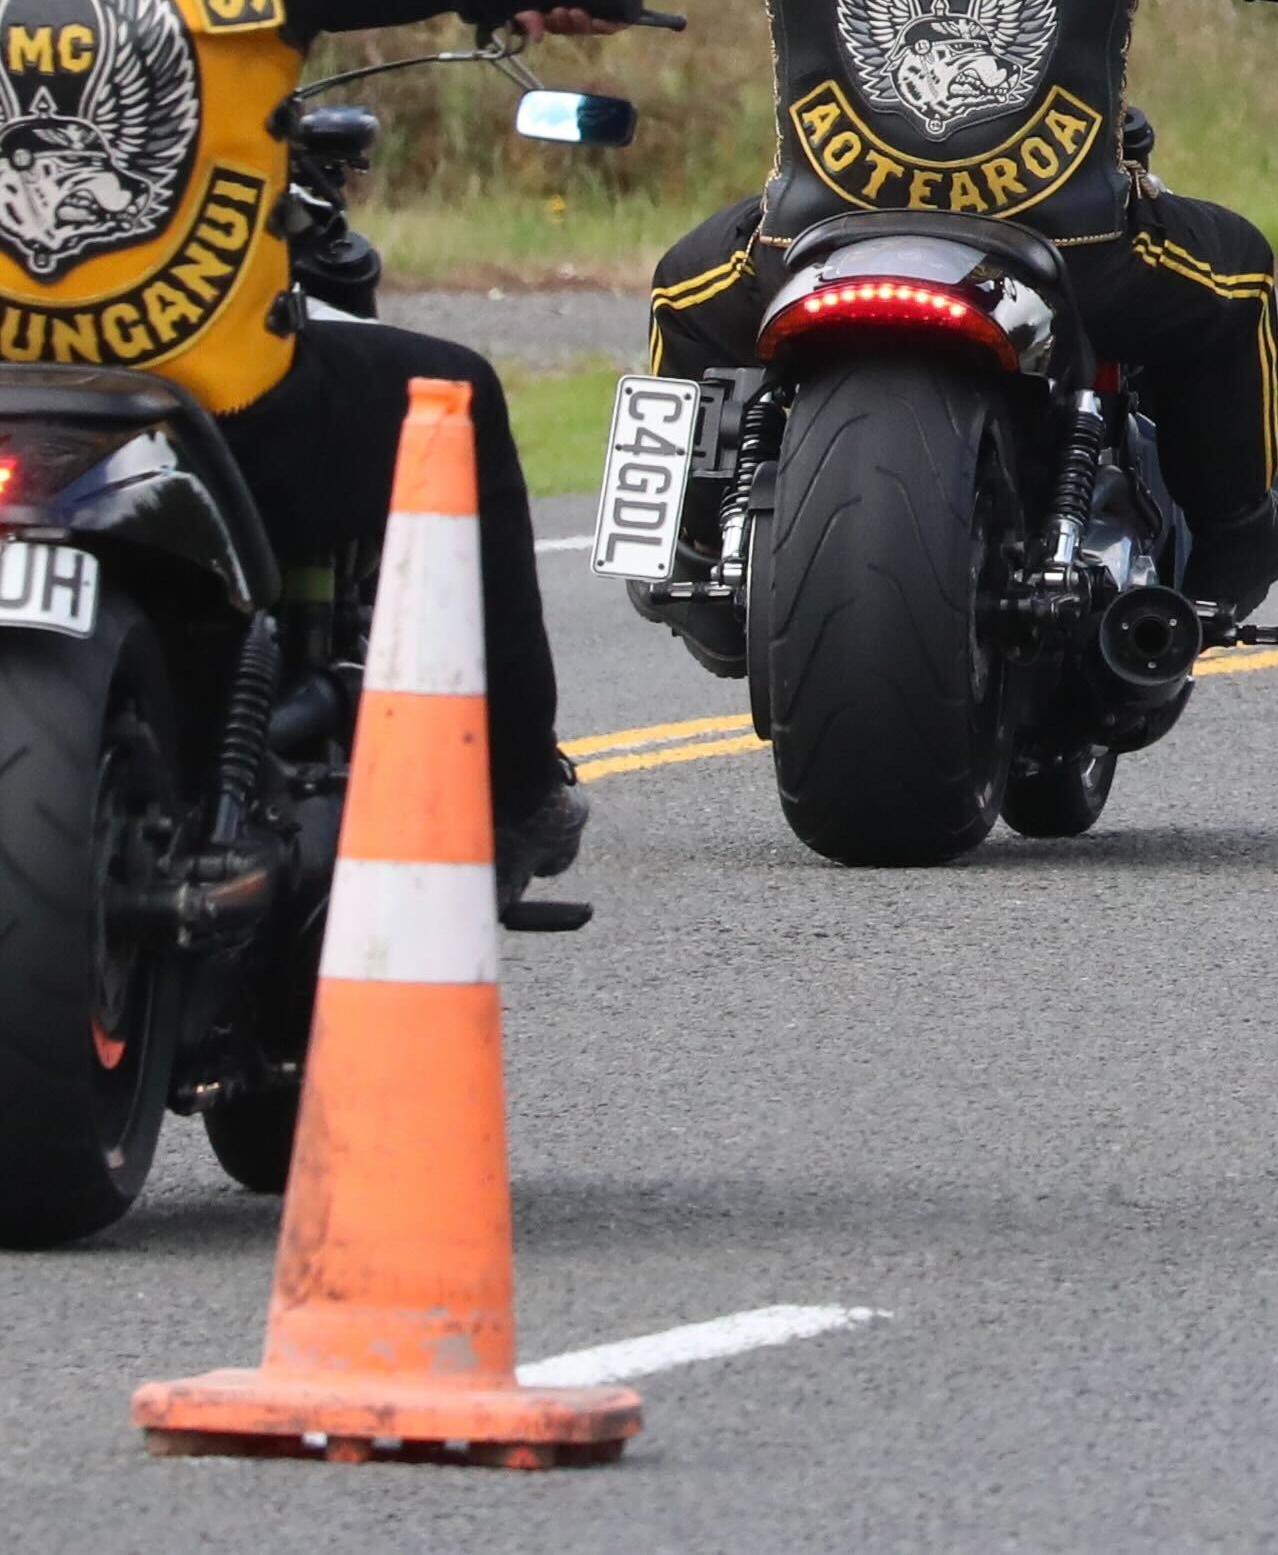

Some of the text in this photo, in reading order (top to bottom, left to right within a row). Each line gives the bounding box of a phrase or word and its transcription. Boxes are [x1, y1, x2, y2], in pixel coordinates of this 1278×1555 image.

[8, 23, 94, 75] MC
[801, 101, 1087, 213] AOTEAROA
[604, 390, 683, 563] C4GDL
